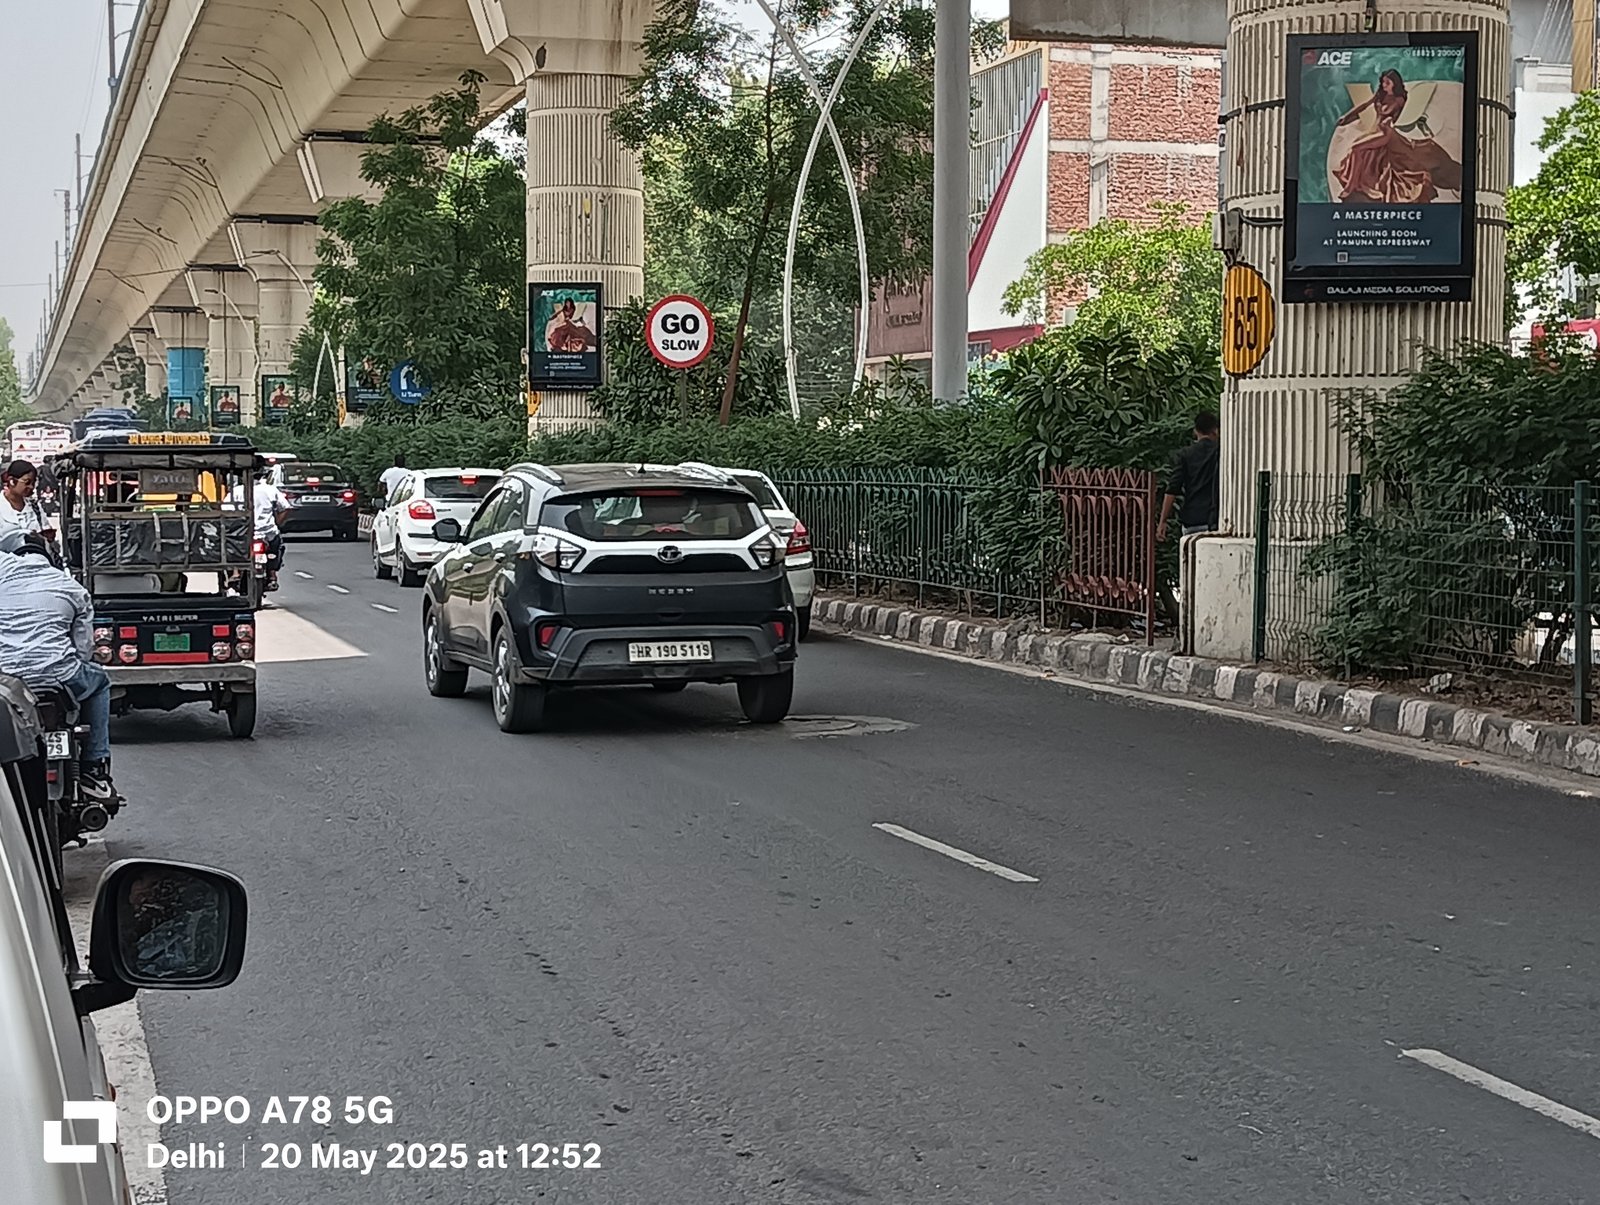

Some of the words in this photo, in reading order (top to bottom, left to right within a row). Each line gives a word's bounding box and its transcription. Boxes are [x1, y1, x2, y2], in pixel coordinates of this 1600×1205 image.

[1318, 51, 1352, 65] ACE
[1332, 211, 1341, 220] A
[1345, 211, 1422, 220] MASTERPIECE
[1327, 286, 1362, 294] BALAJI
[1363, 286, 1394, 294] MEDIA
[1395, 285, 1450, 294] SOLUTIONS
[661, 313, 700, 334] GO
[1234, 296, 1258, 351] 65
[662, 339, 700, 350] SLOW
[637, 645, 652, 658] HR
[680, 644, 709, 657] 5119
